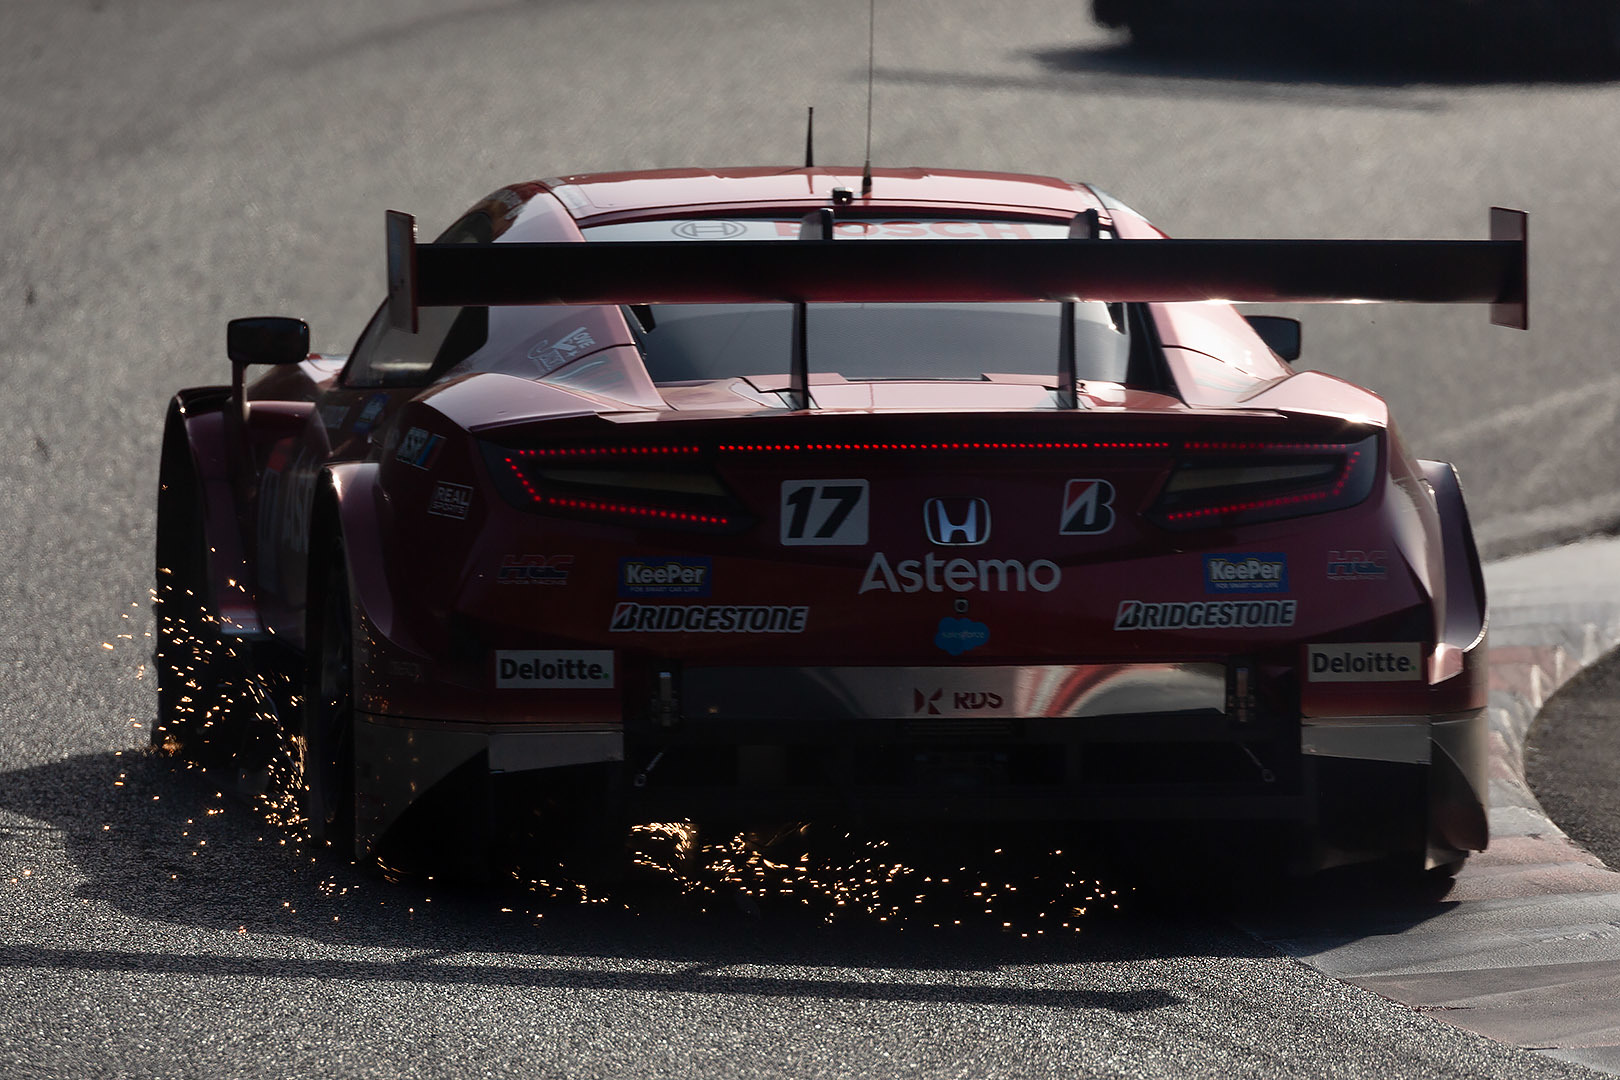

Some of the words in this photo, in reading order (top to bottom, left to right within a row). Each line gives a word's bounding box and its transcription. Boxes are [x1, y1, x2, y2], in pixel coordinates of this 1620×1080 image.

[434, 486, 470, 506] REAL
[786, 485, 864, 539] 17
[624, 561, 706, 586] KeePer
[858, 551, 1063, 595] Astemo
[1208, 558, 1283, 582] KeePer
[610, 603, 809, 632] BRIDGESTONE
[1114, 600, 1297, 630] BRIDGESTONE
[500, 657, 609, 681] Deloitte.
[1312, 651, 1417, 674] Deloitte.
